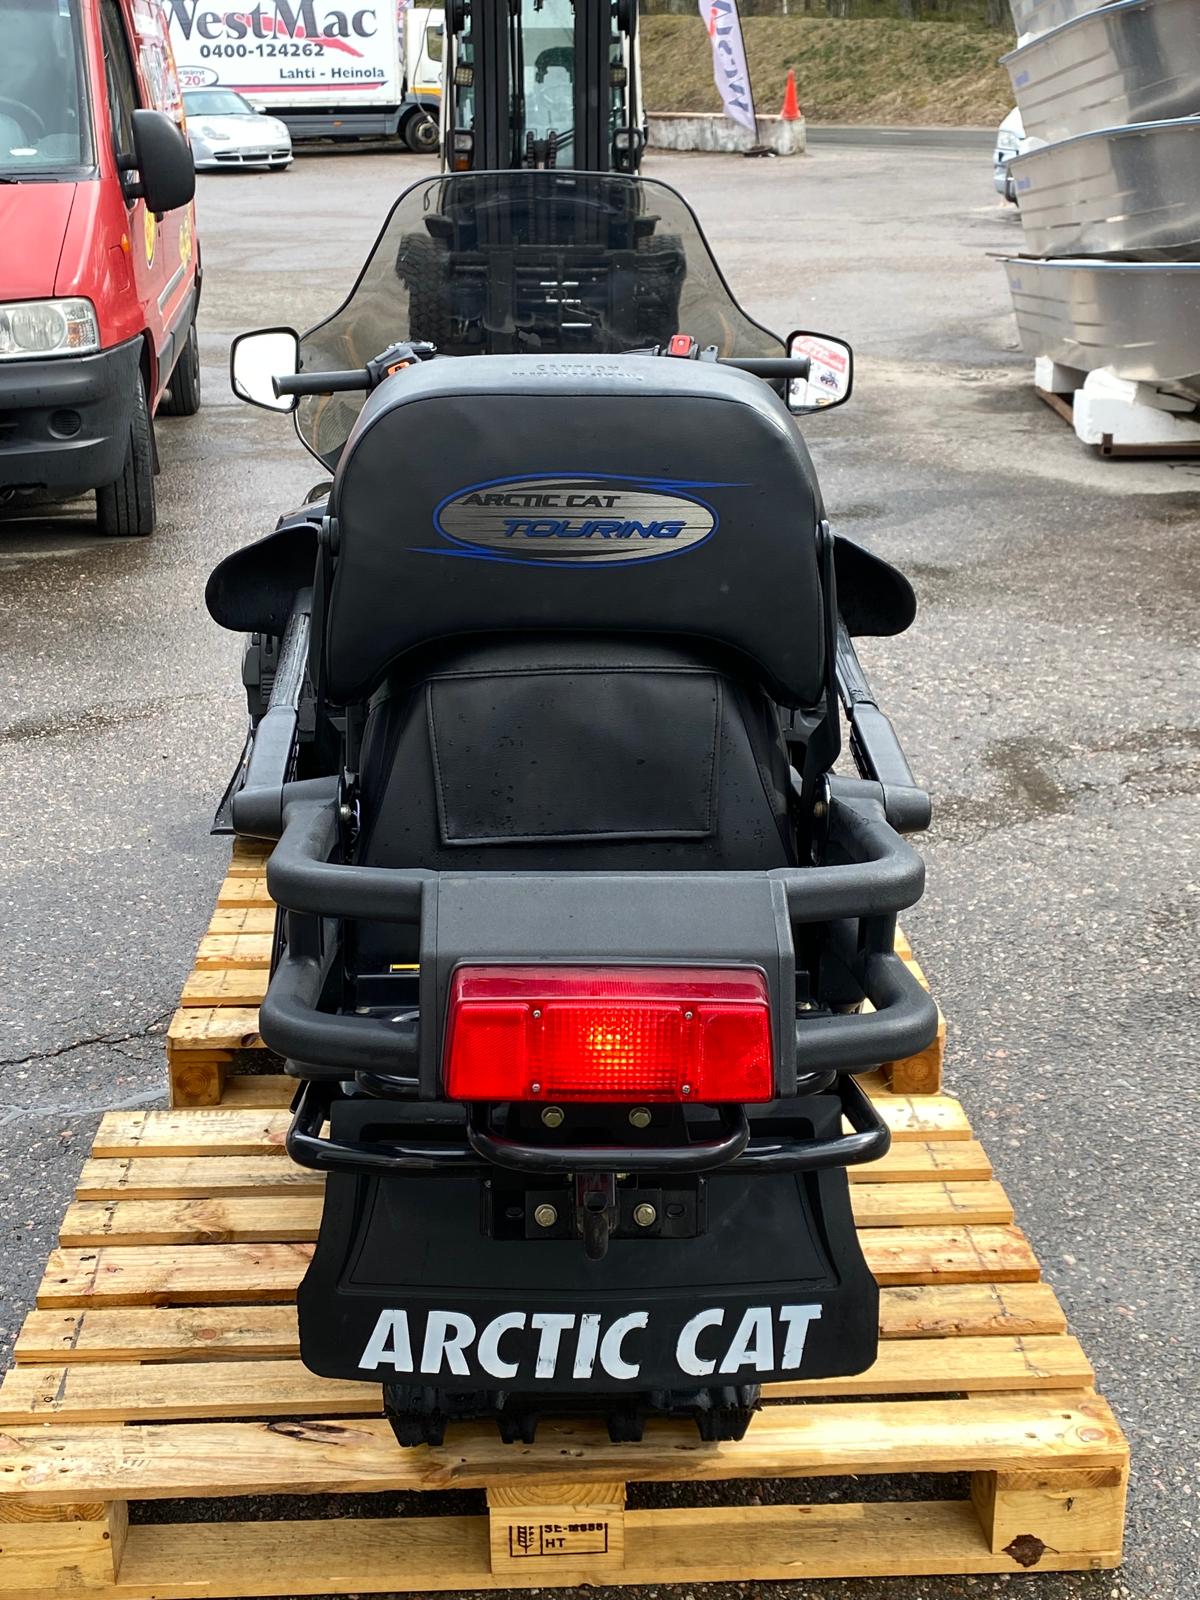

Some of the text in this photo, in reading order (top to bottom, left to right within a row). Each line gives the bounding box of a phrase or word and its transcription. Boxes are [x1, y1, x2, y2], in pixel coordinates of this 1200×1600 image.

[200, 43, 325, 58] 0400-124262
[280, 67, 315, 79] Lahti
[331, 66, 385, 78] Heinola
[459, 493, 621, 508] ARCTIC CAT
[502, 519, 687, 539] TOURING
[357, 1304, 823, 1380] ARCTIC CAT
[545, 1537, 567, 1548] HT
